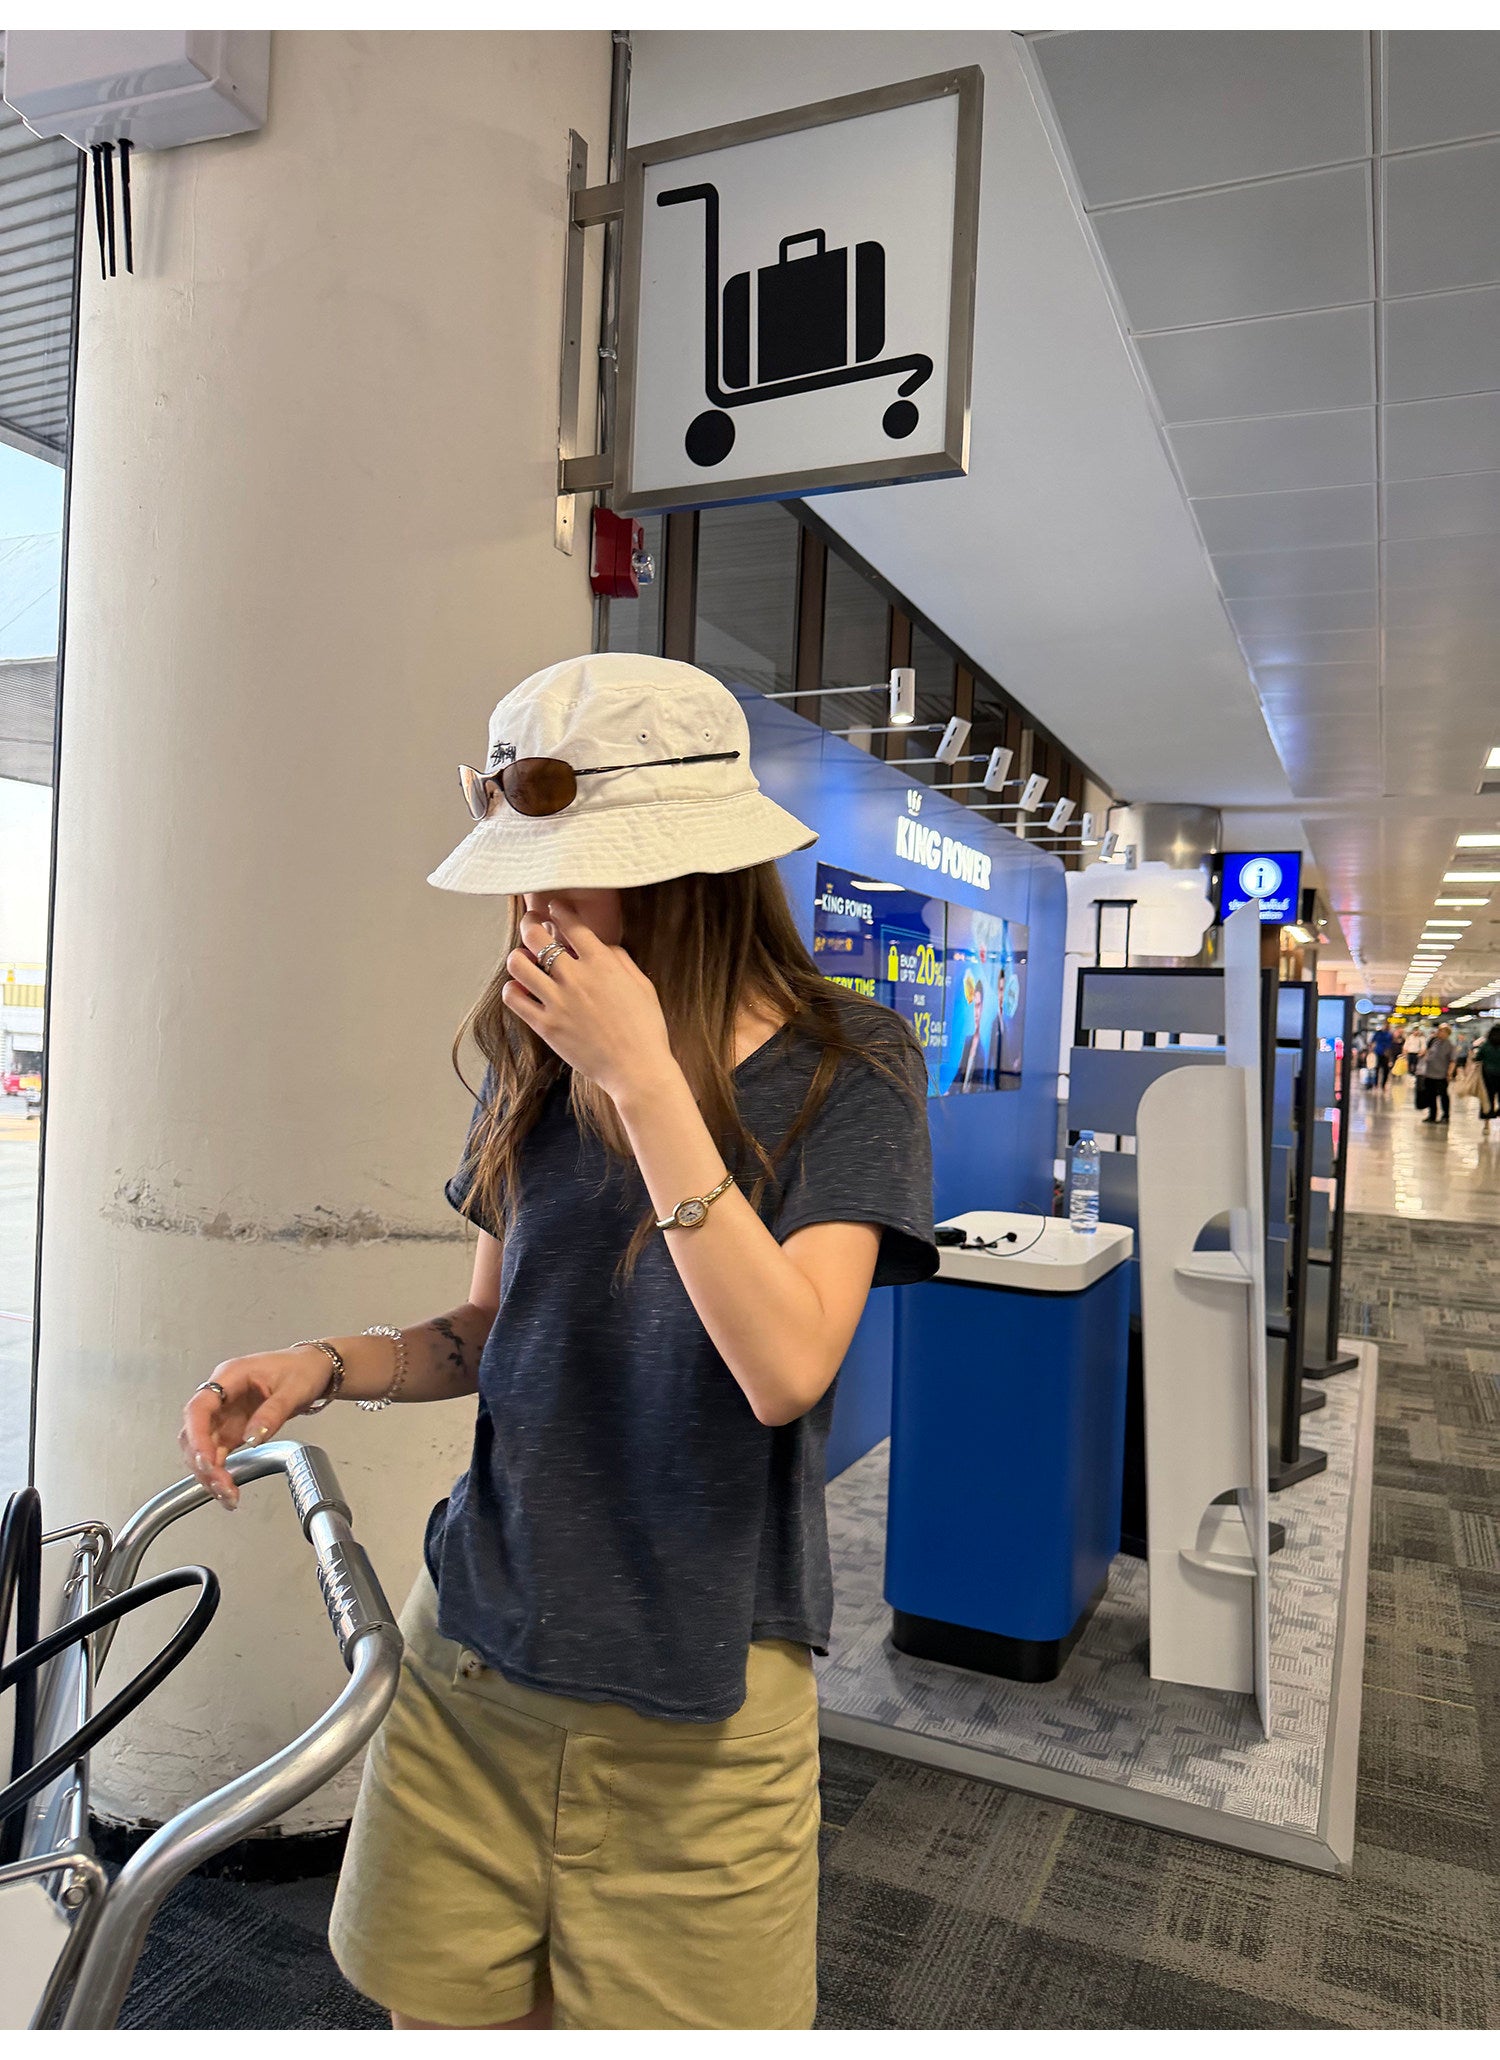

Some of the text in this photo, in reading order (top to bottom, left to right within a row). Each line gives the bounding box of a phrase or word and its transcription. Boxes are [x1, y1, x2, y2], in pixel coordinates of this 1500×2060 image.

[896, 815, 991, 890] KING POWER
[822, 893, 873, 920] KING POWER
